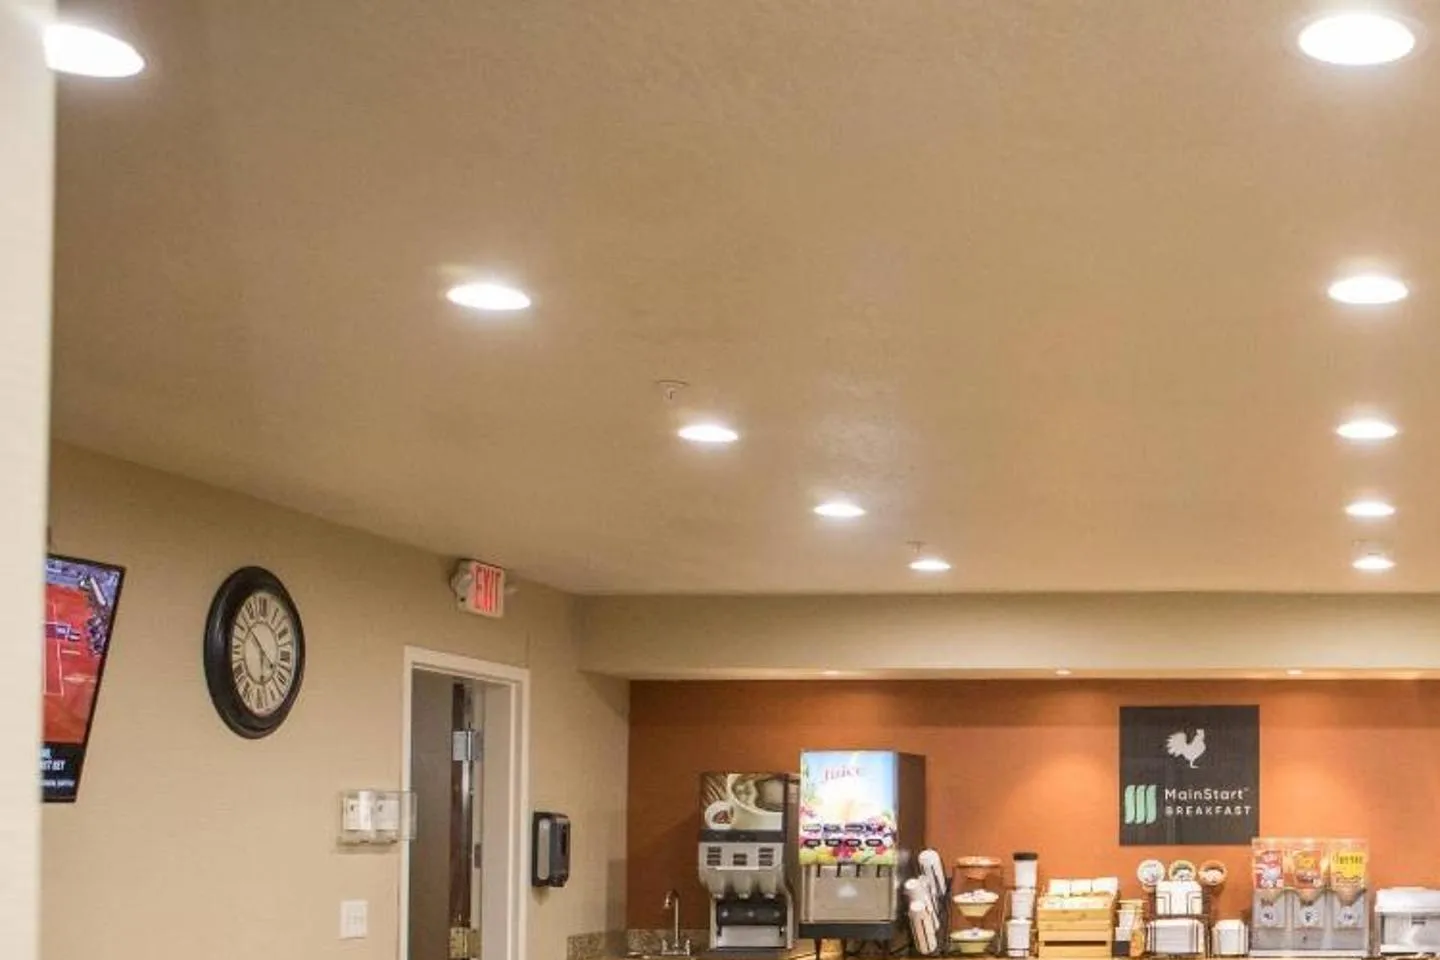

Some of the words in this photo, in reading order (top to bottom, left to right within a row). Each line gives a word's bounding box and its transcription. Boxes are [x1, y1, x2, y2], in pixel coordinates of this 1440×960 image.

[475, 565, 501, 614] EXIT
[1164, 788, 1244, 801] MainStart
[1165, 805, 1252, 816] BREAKFAST
